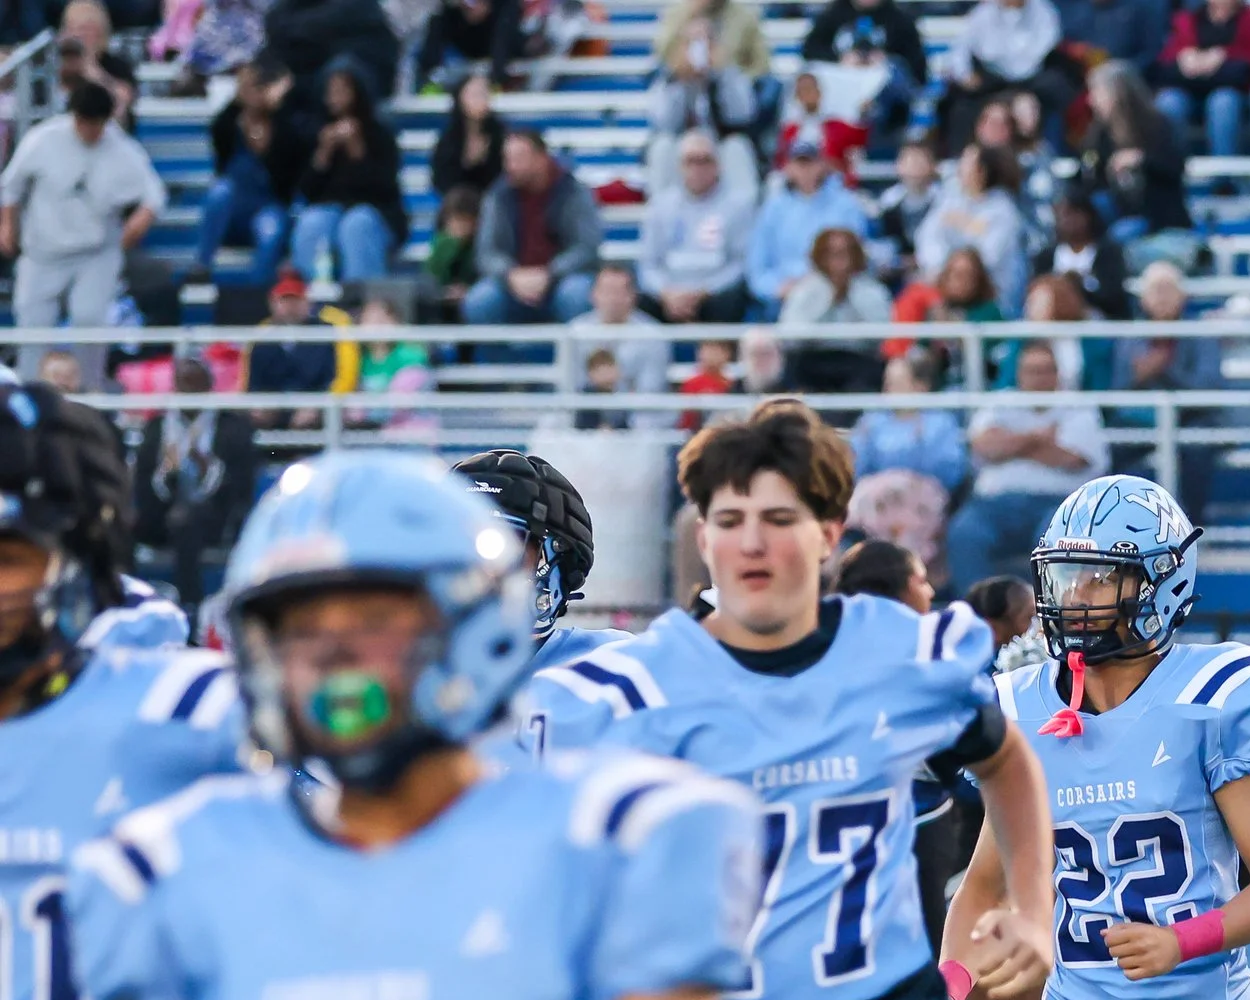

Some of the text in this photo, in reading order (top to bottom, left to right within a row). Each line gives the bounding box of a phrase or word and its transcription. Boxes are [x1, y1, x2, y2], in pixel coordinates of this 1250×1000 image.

[1057, 540, 1092, 551] Riddell
[1111, 547, 1138, 555] OAKLEY
[753, 755, 860, 789] CORSAIRS
[1057, 780, 1136, 807] CORSAIRS
[1053, 810, 1199, 970] 22
